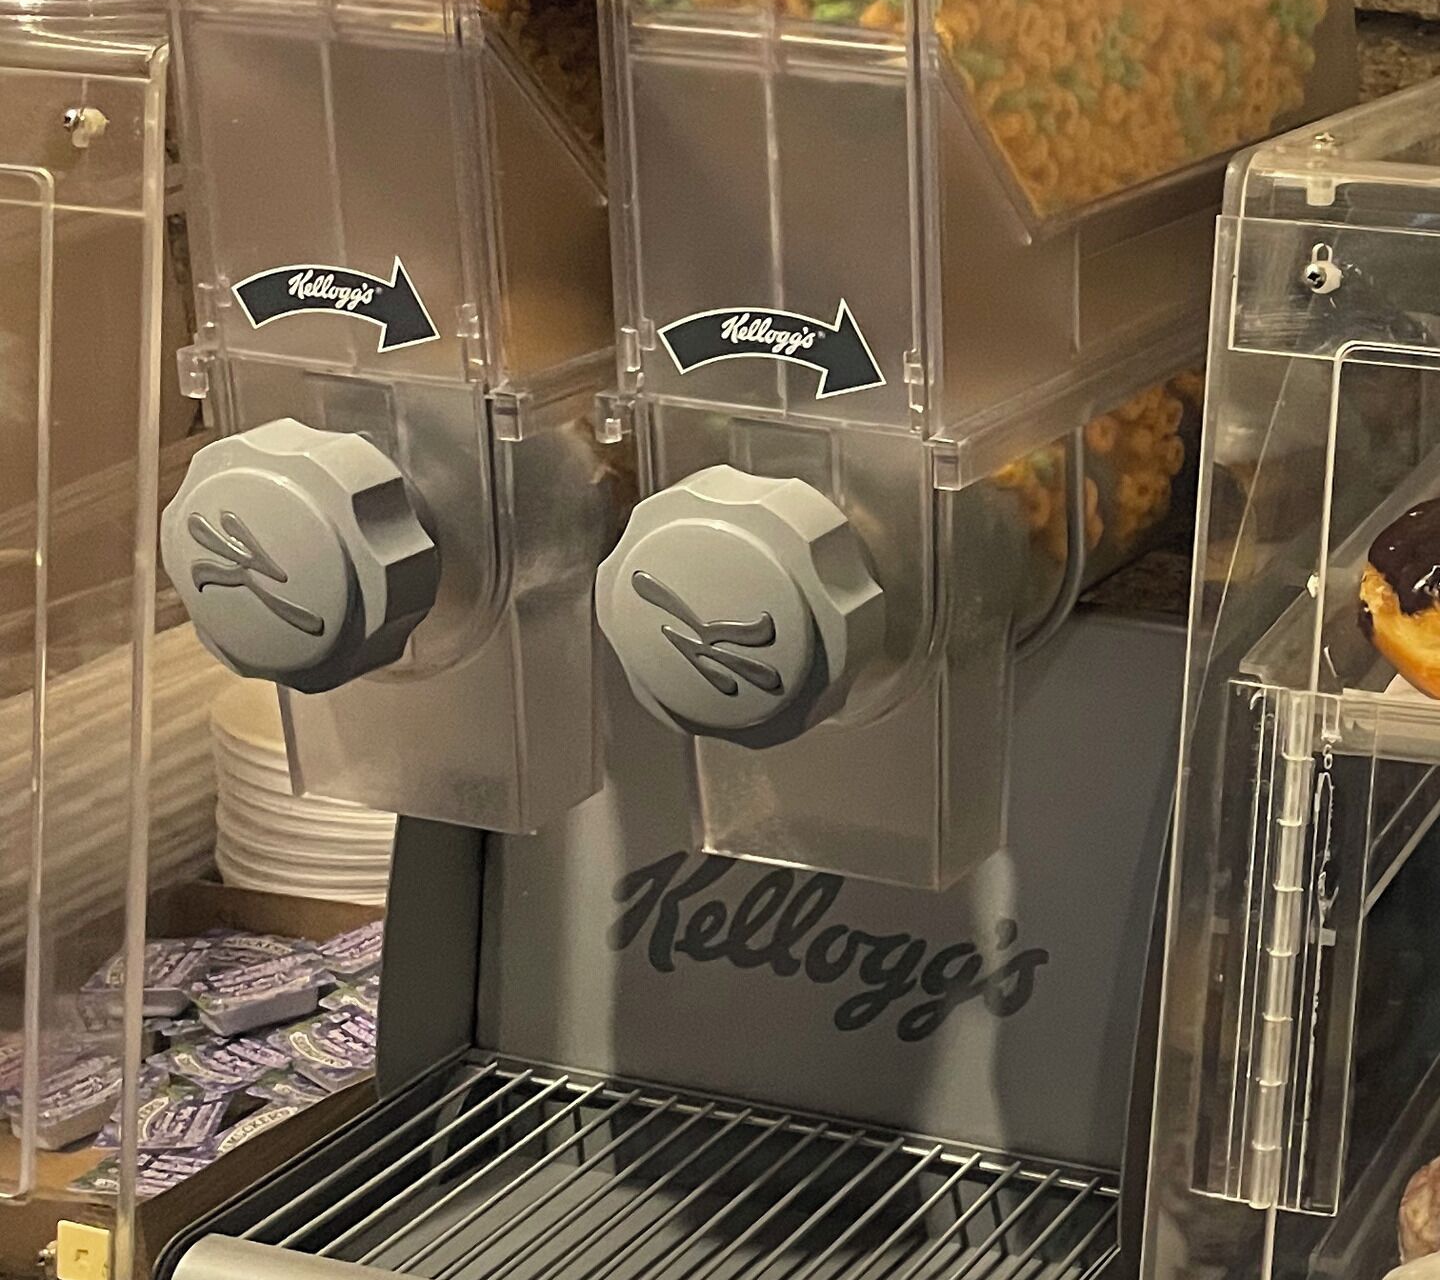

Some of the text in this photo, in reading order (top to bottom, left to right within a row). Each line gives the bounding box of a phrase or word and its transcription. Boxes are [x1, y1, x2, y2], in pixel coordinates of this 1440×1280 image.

[287, 268, 376, 306] Kellogg's
[720, 312, 818, 354] Kellogg's
[609, 851, 1050, 1043] Kellogg's
